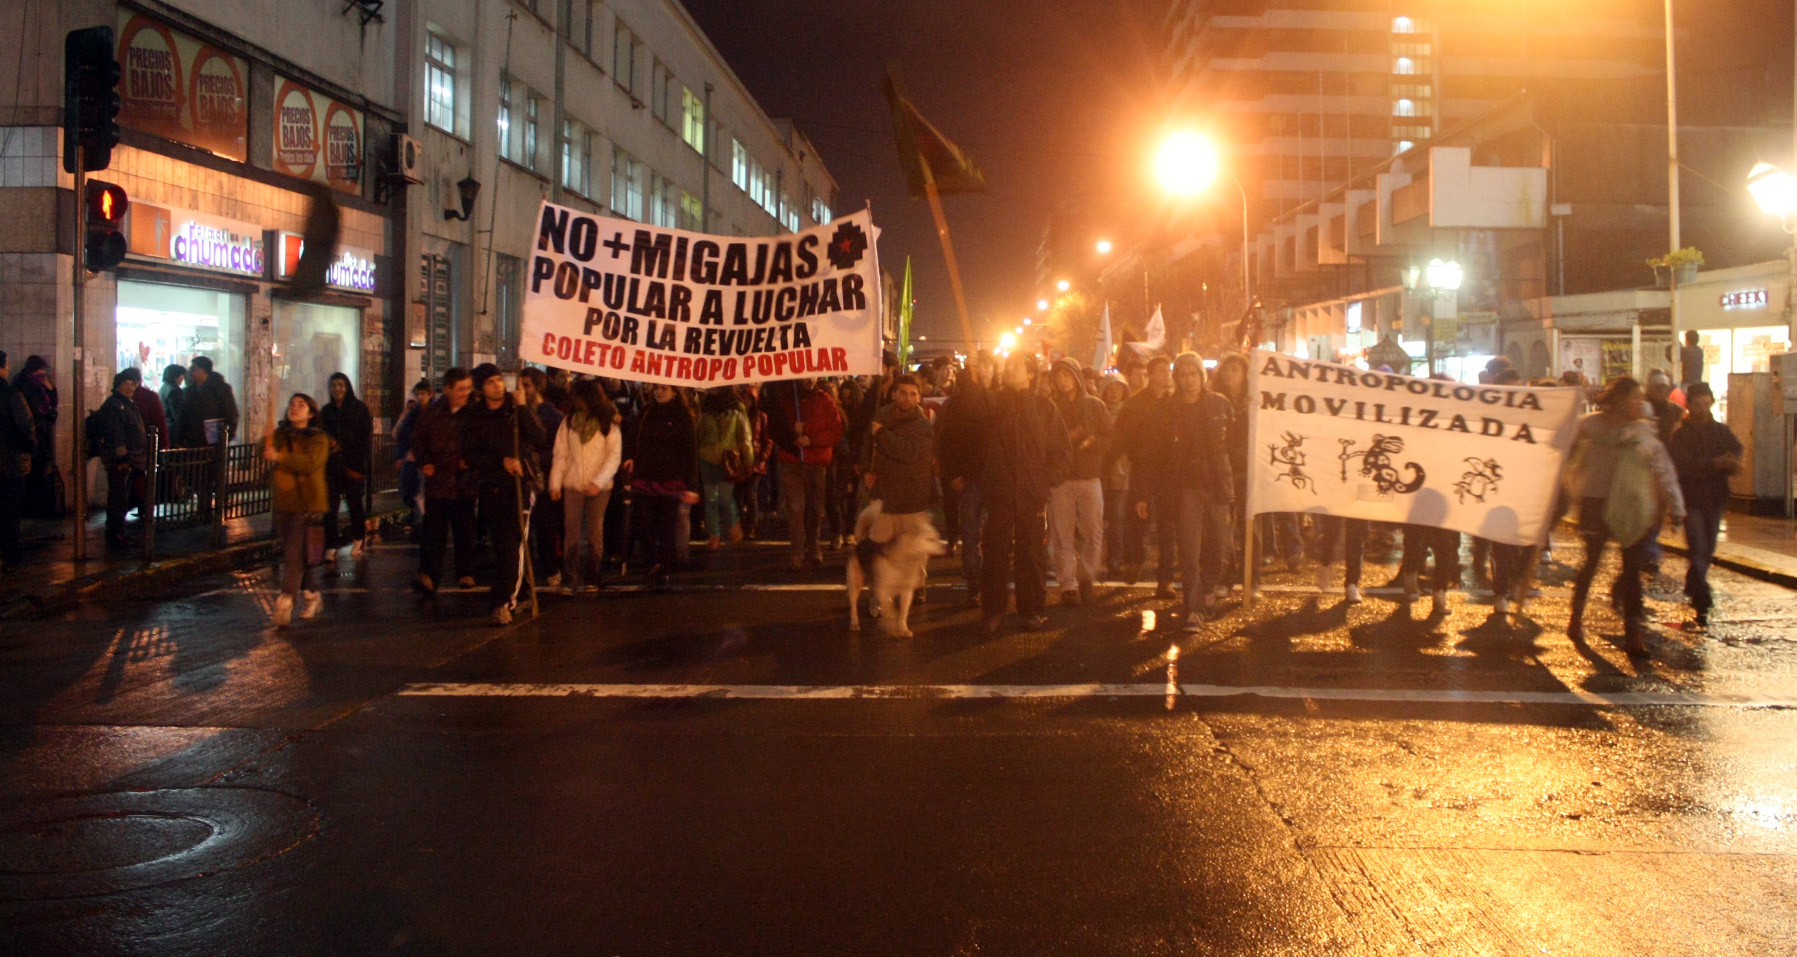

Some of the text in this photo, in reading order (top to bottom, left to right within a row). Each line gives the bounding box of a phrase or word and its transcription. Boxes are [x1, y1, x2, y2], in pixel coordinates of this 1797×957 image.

[129, 47, 172, 71] PRECIOS
[130, 69, 172, 99] BAJOS
[199, 74, 235, 96] PRECIOS
[282, 106, 311, 125] PRECIOS
[282, 125, 311, 149] BAJOS
[329, 125, 354, 142] PRECIOS
[329, 142, 355, 165] BAJOS
[170, 234, 265, 274] ahumada
[531, 255, 866, 326] POPULAR A LUCHAR
[583, 306, 812, 356] POR LA REVUELTA
[541, 332, 849, 382] COLETO ANTROPO POPULAR
[1260, 356, 1544, 411] ANTROPOLOGIA
[1260, 390, 1537, 444] MOVILIZADA
